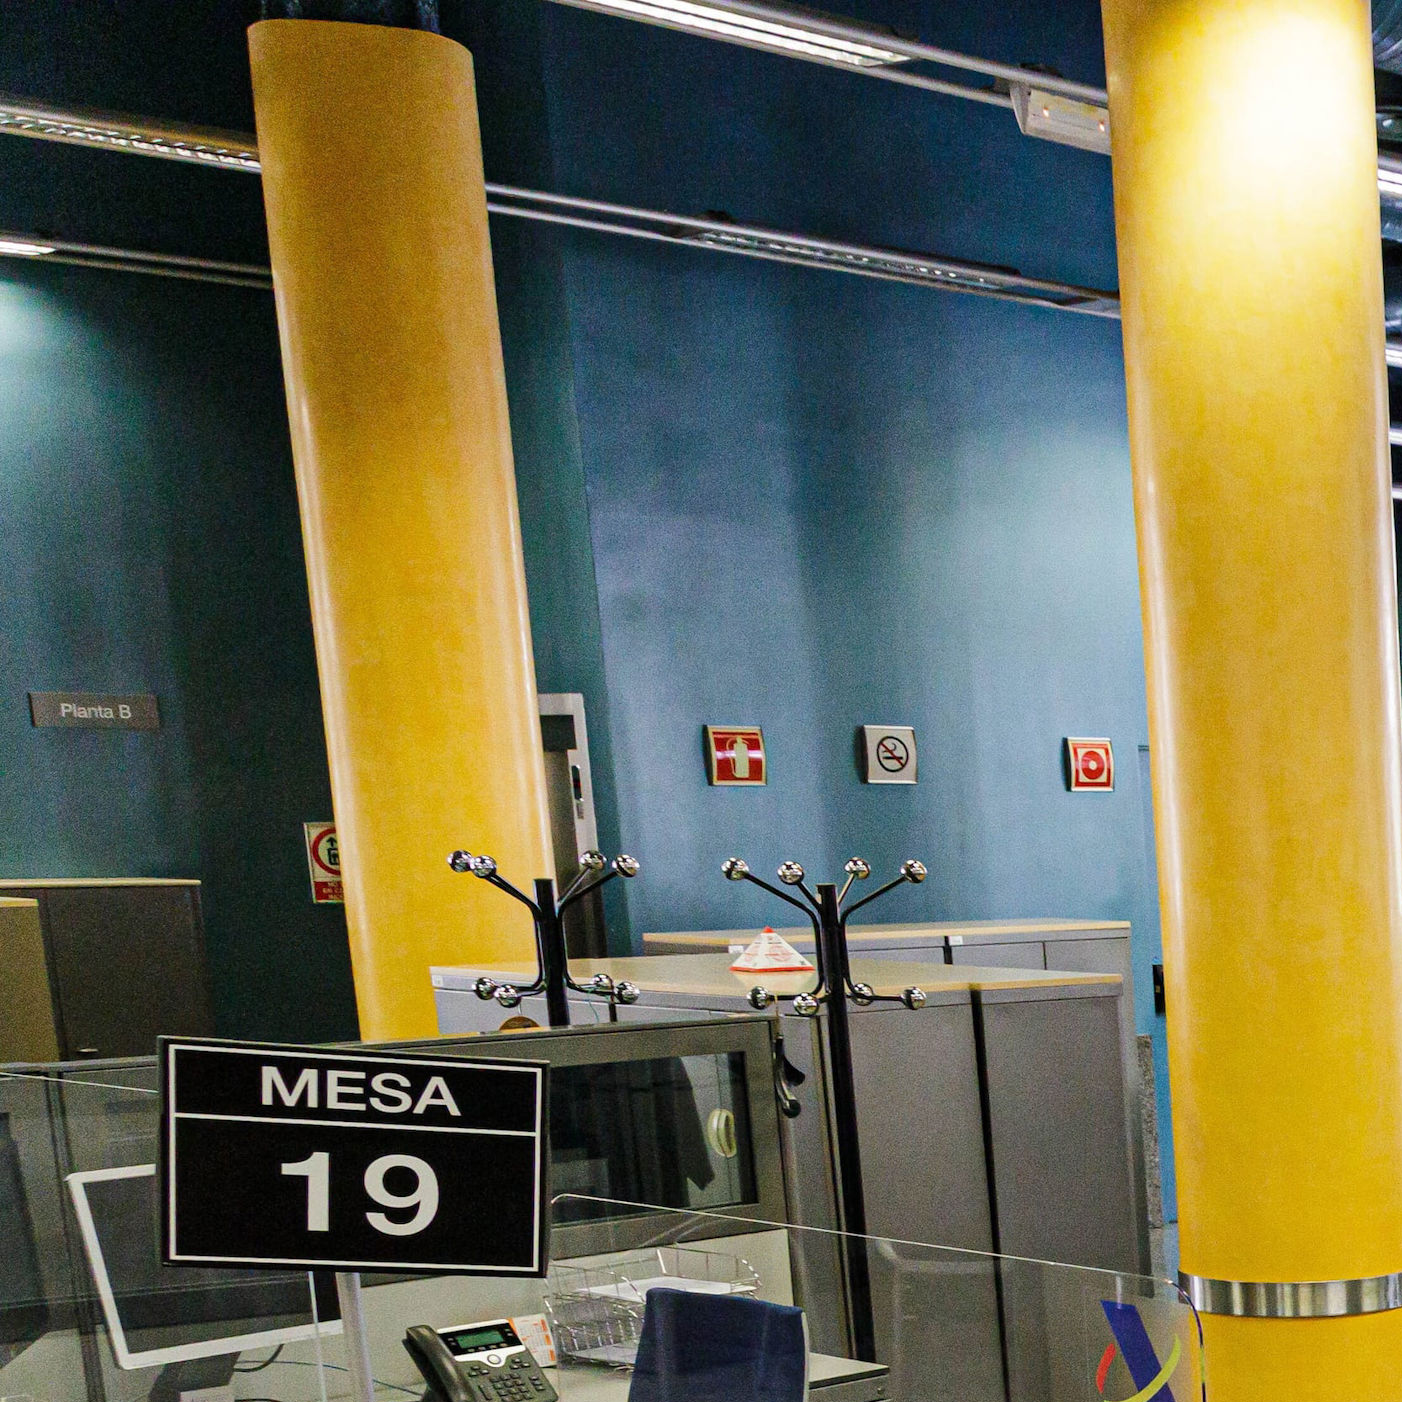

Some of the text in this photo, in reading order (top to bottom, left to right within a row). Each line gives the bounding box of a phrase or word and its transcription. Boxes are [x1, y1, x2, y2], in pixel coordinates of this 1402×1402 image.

[60, 702, 131, 719] Planta B
[260, 1065, 462, 1117] MESA
[281, 1151, 440, 1236] 19
